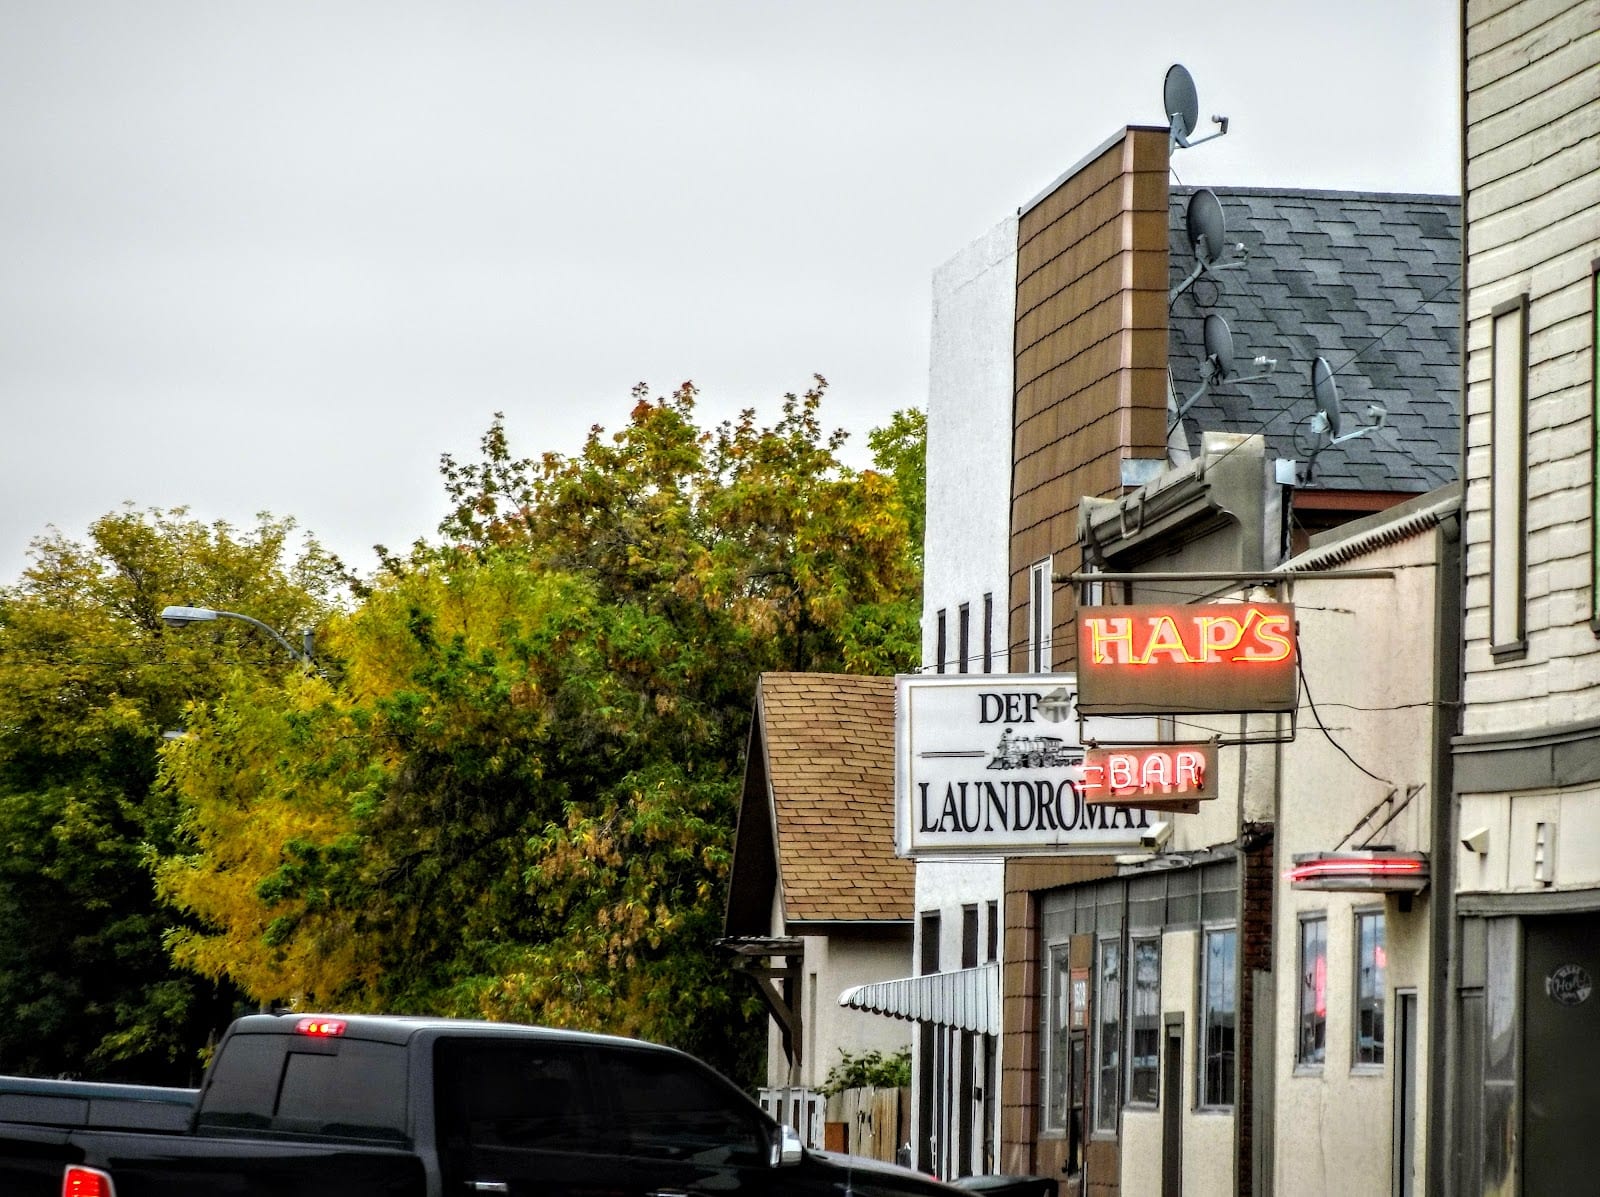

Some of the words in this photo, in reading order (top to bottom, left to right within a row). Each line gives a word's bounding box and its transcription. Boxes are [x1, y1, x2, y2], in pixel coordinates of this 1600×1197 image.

[1085, 608, 1292, 665] HAP'S
[978, 692, 1089, 724] DEP
[1108, 750, 1207, 797] BAR
